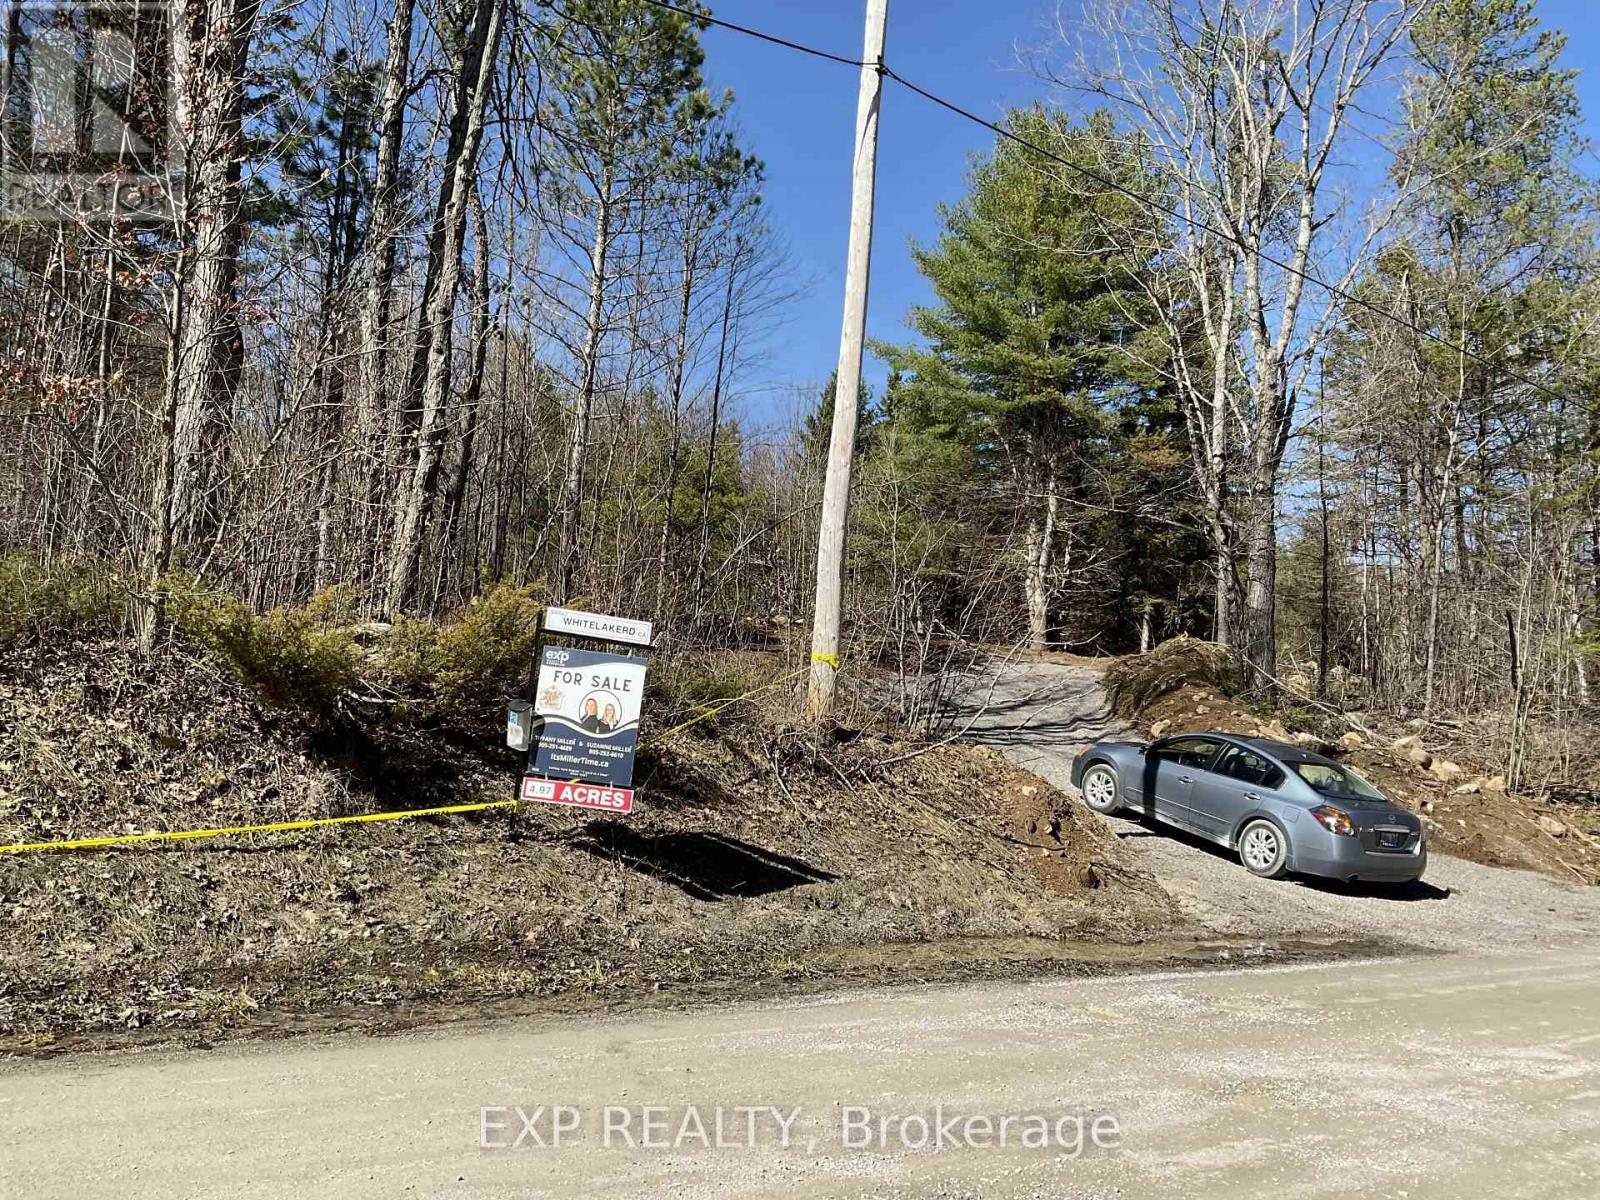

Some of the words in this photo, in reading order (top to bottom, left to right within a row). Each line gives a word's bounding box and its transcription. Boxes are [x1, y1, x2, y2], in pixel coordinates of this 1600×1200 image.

[553, 670, 582, 686] FOR
[591, 675, 632, 692] SALE
[550, 753, 609, 768] ItsMillerTime.ca
[529, 784, 552, 795] 4.97
[559, 786, 625, 808] ACRES
